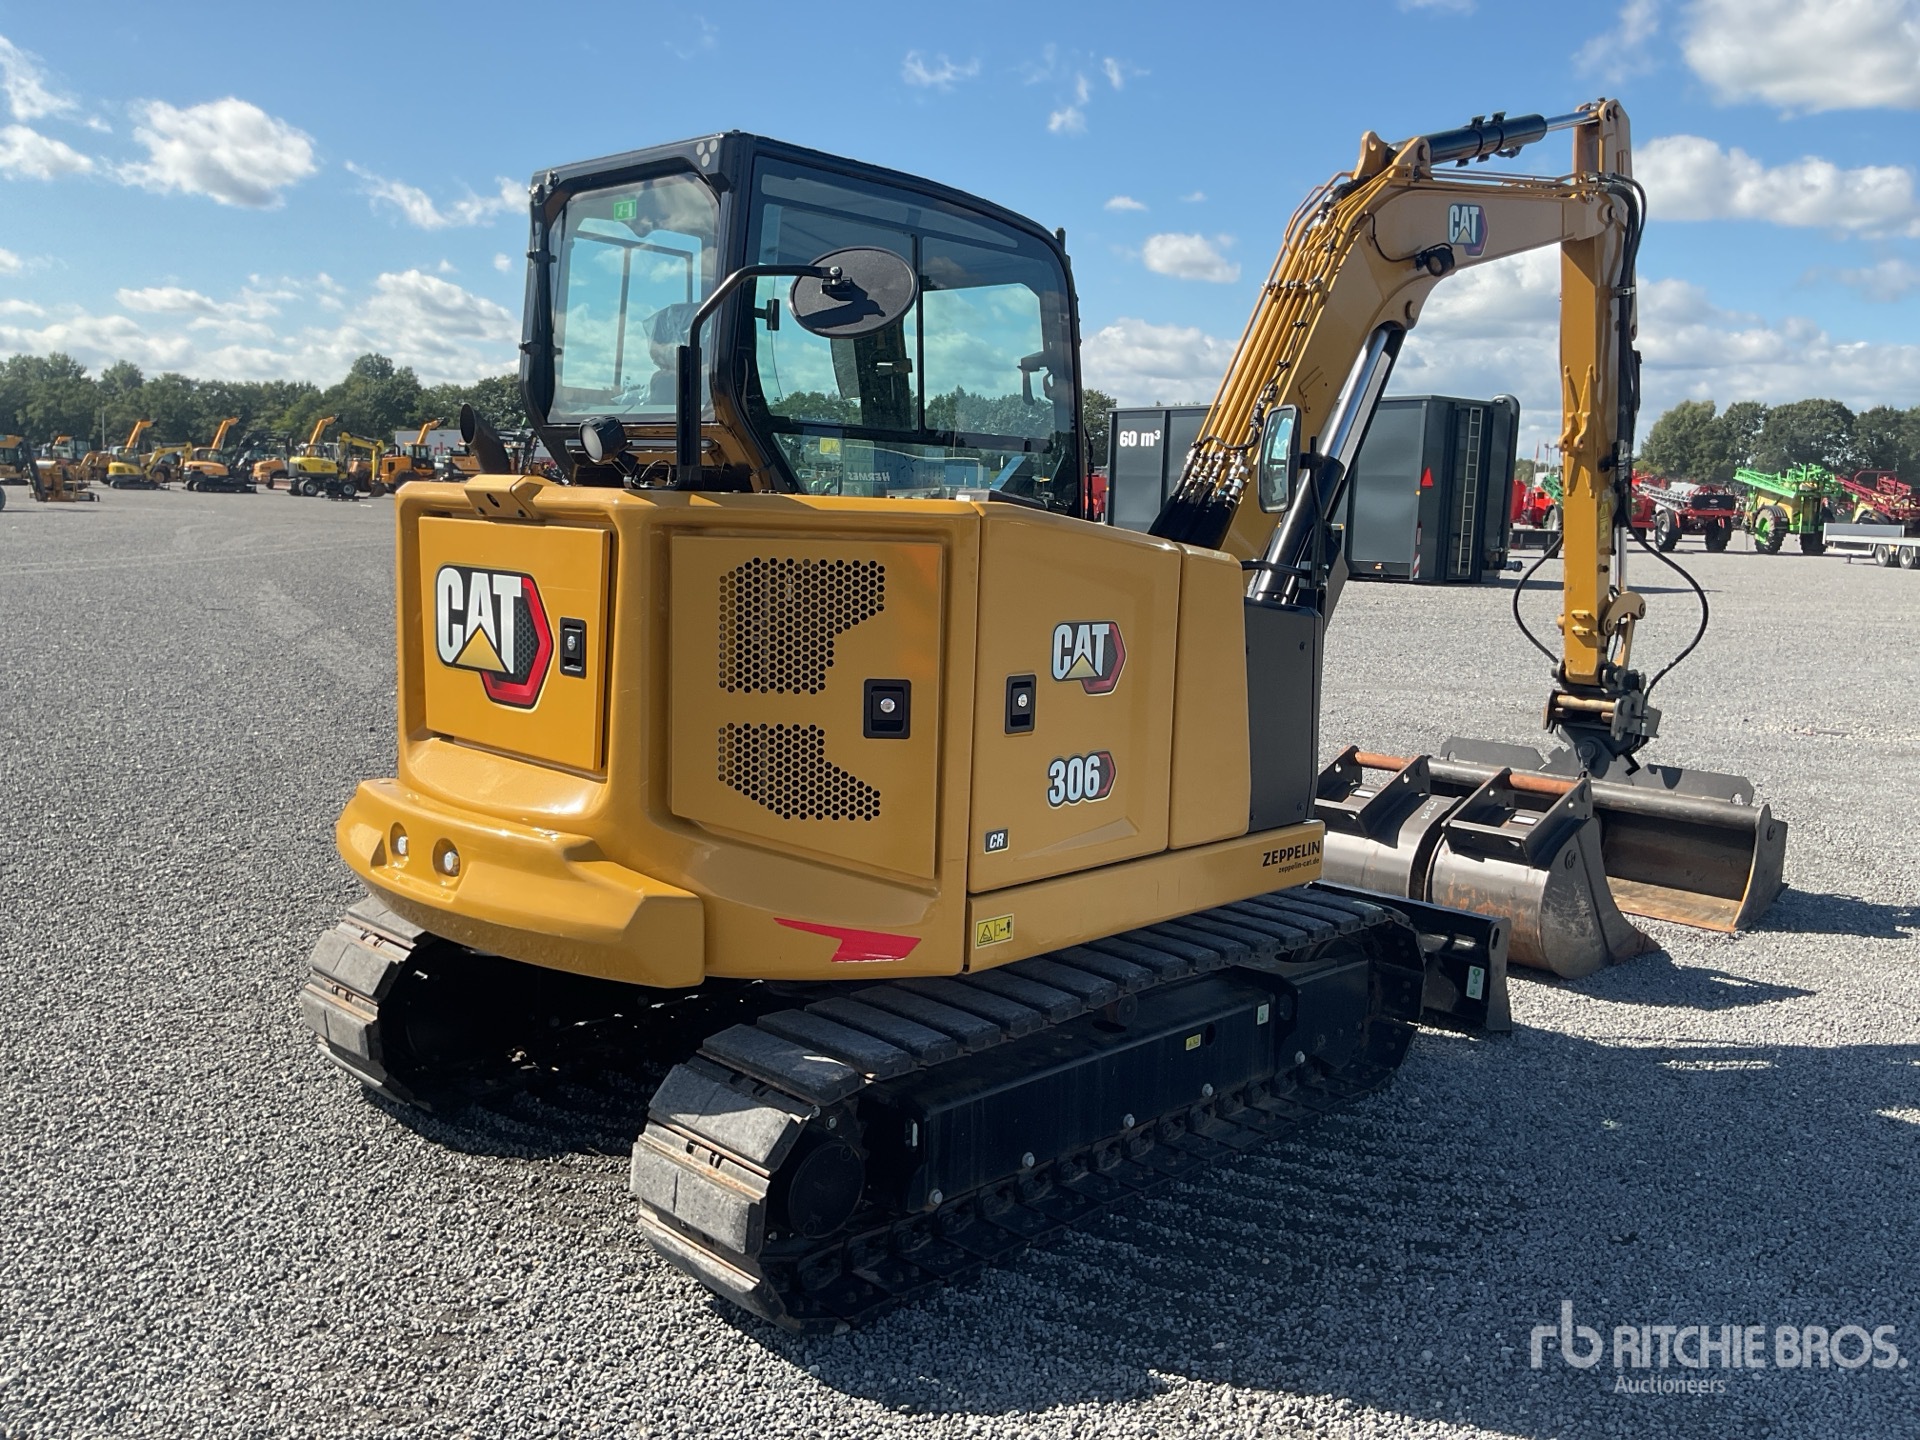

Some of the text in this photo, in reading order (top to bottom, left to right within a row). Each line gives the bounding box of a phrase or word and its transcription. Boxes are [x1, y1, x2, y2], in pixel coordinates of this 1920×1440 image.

[1450, 205, 1479, 244] CAT
[1119, 430, 1138, 448] 60
[437, 567, 522, 674] CAT
[1053, 623, 1110, 680] CAT
[1049, 755, 1101, 804] 306
[989, 832, 1005, 849] CR
[1262, 840, 1321, 868] ZEPPELIN
[1278, 856, 1320, 873] zeppelin-cat.de
